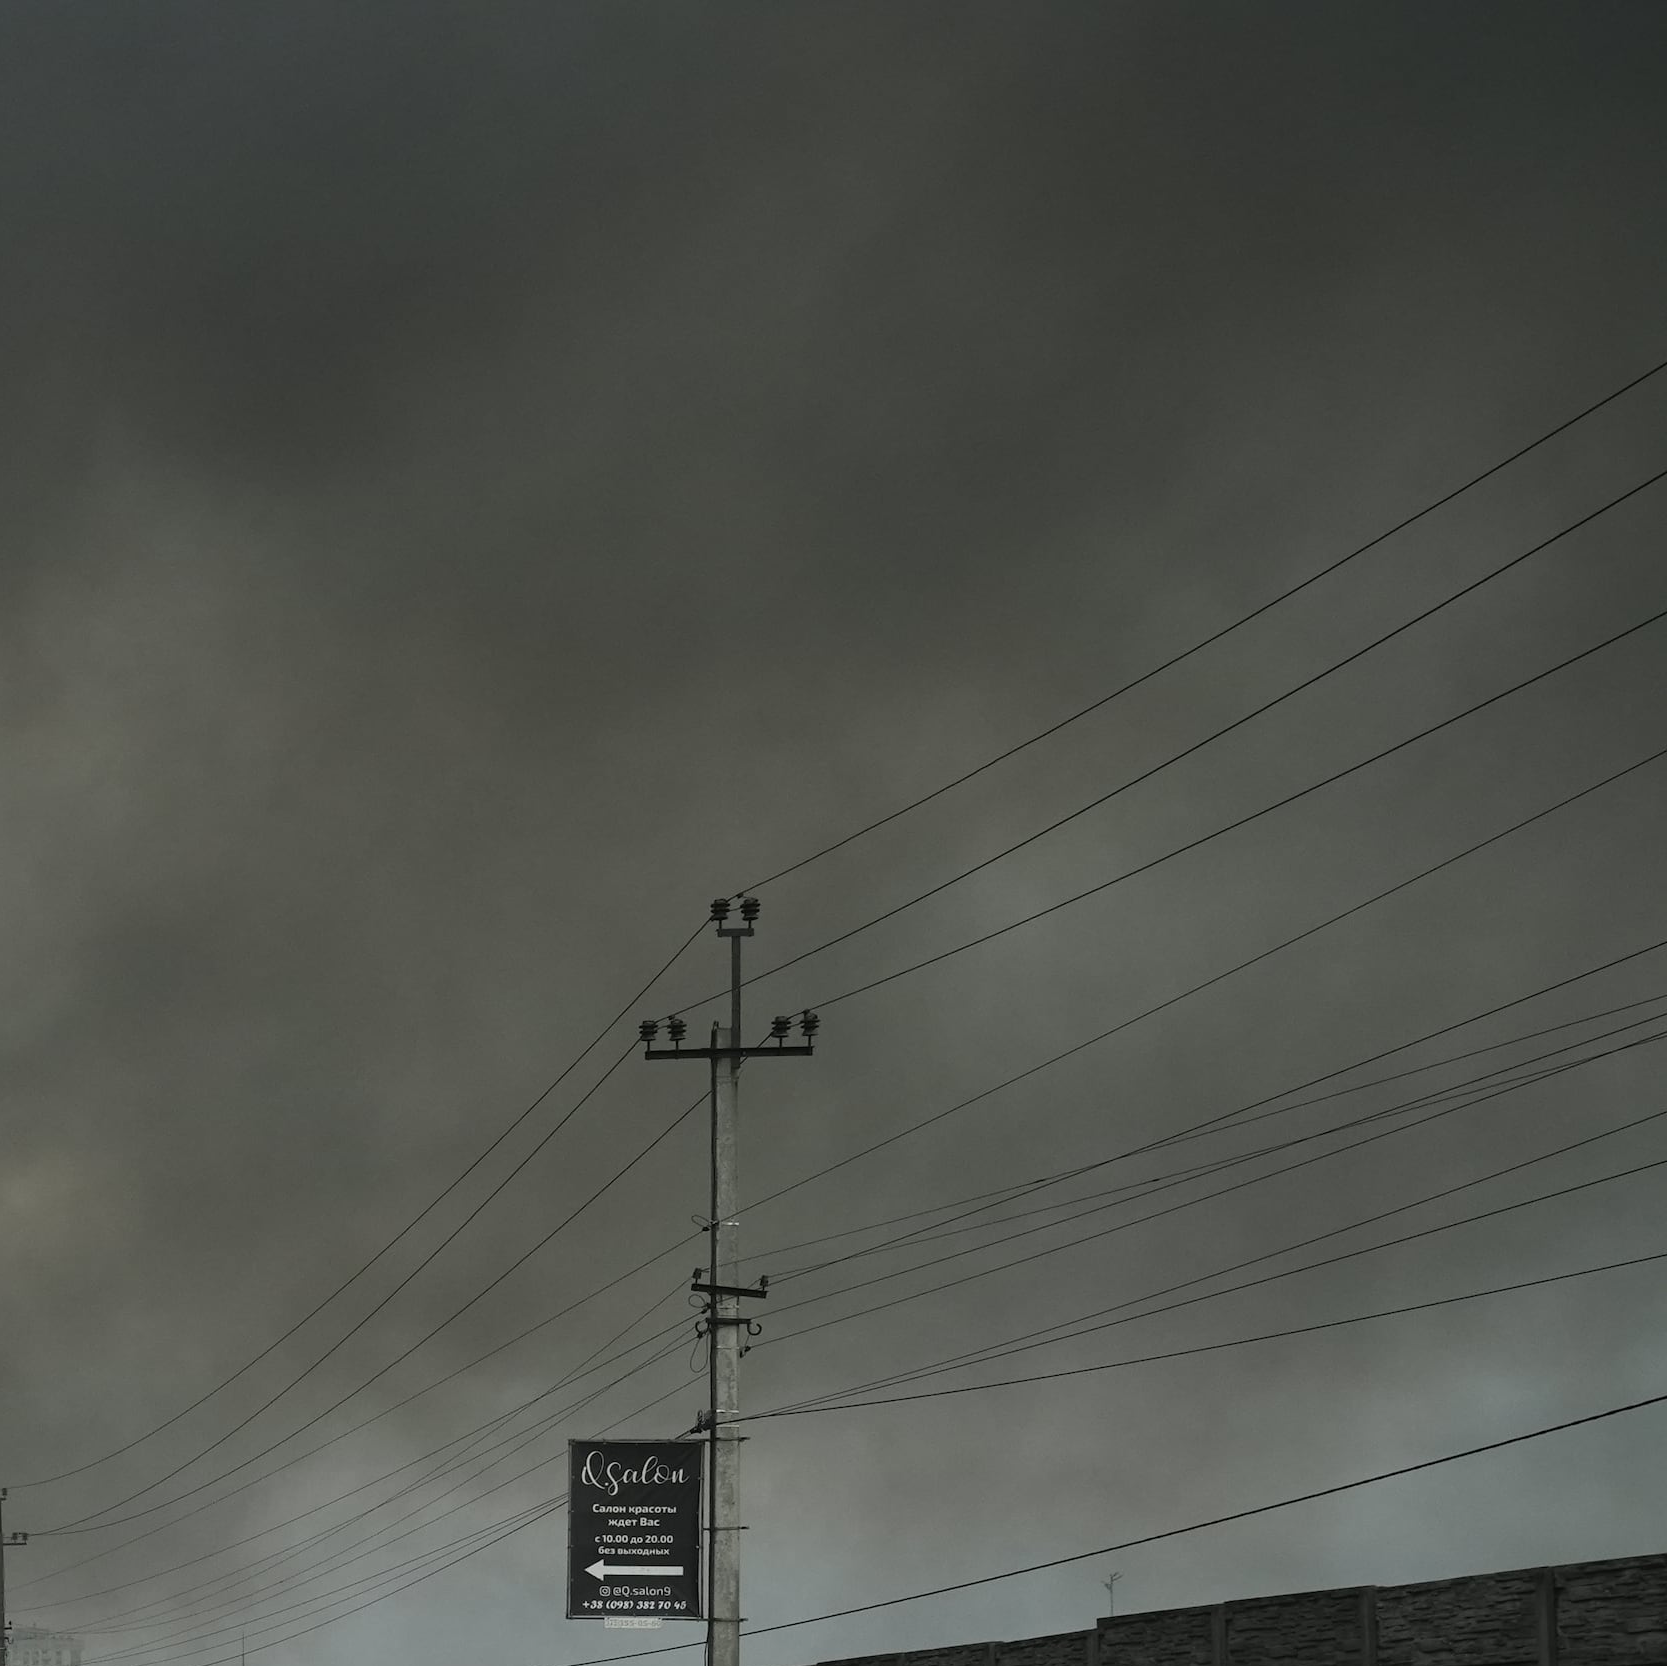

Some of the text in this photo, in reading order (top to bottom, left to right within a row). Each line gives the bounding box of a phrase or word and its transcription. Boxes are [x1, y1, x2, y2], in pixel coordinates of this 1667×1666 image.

[592, 1503, 677, 1515] Салон красоты
[608, 1517, 660, 1527] ждет Вас
[602, 1535, 628, 1543] 10.00
[630, 1536, 643, 1544] до
[645, 1535, 674, 1543] 20.00
[598, 1546, 670, 1556] без выходных
[613, 1586, 671, 1597] @Q.salon9
[582, 1600, 603, 1609] +38
[606, 1600, 634, 1610] (098)
[636, 1600, 655, 1609] 382
[657, 1600, 671, 1609] 70
